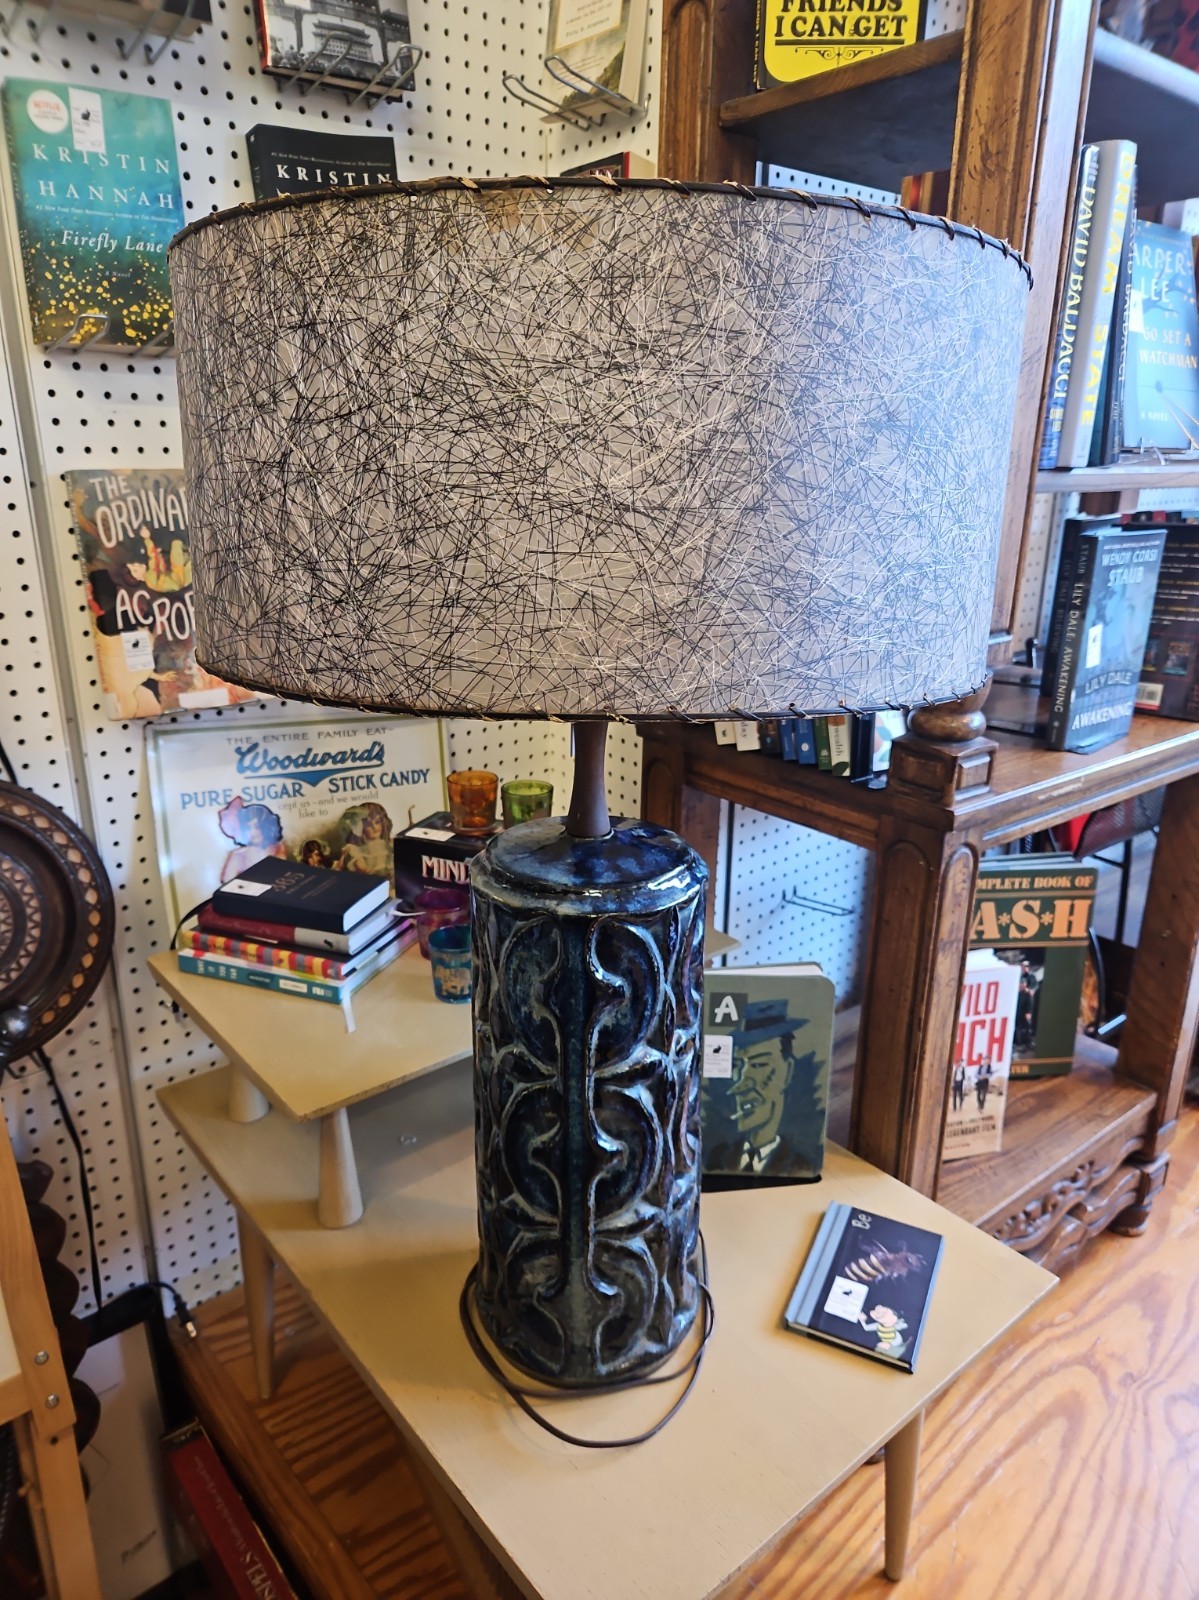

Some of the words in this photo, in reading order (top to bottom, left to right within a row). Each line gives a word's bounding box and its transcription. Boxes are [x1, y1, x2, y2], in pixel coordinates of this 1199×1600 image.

[781, 0, 903, 12] FRIENDS
[775, 15, 784, 37] I
[790, 15, 847, 37] CAN
[854, 15, 908, 37] GET
[32, 144, 170, 174] KRISTIN
[276, 164, 392, 186] KRISTIN
[38, 180, 174, 208] HANNAH
[1072, 184, 1096, 270] DAVID
[1101, 154, 1135, 294] DREAM
[61, 230, 118, 253] Firefly
[125, 235, 164, 253] Lane
[1141, 276, 1171, 303] LEE
[1054, 277, 1084, 398] BALDACCI
[1143, 327, 1157, 341] GO
[1162, 328, 1181, 344] SET
[1184, 332, 1192, 346] A
[1138, 348, 1198, 369] WATCHMAN
[1080, 324, 1108, 426] STATE
[89, 473, 131, 502] THE
[1107, 566, 1145, 587] STAUB
[1074, 582, 1085, 606] LILY
[1054, 647, 1073, 712] AWAKENING
[226, 736, 253, 745] THE
[263, 733, 309, 743] ENTIRE
[318, 729, 357, 739] FAMILY
[235, 741, 385, 774] Woodward's
[180, 789, 233, 810] PURE
[242, 781, 305, 803] SUGAR
[329, 774, 377, 794] STICK
[381, 769, 430, 787] CANDY
[1034, 876, 1072, 889] BOOK
[1075, 875, 1094, 887] OF
[714, 995, 739, 1023] A
[961, 981, 999, 1017] ILD
[851, 1213, 872, 1230] Be
